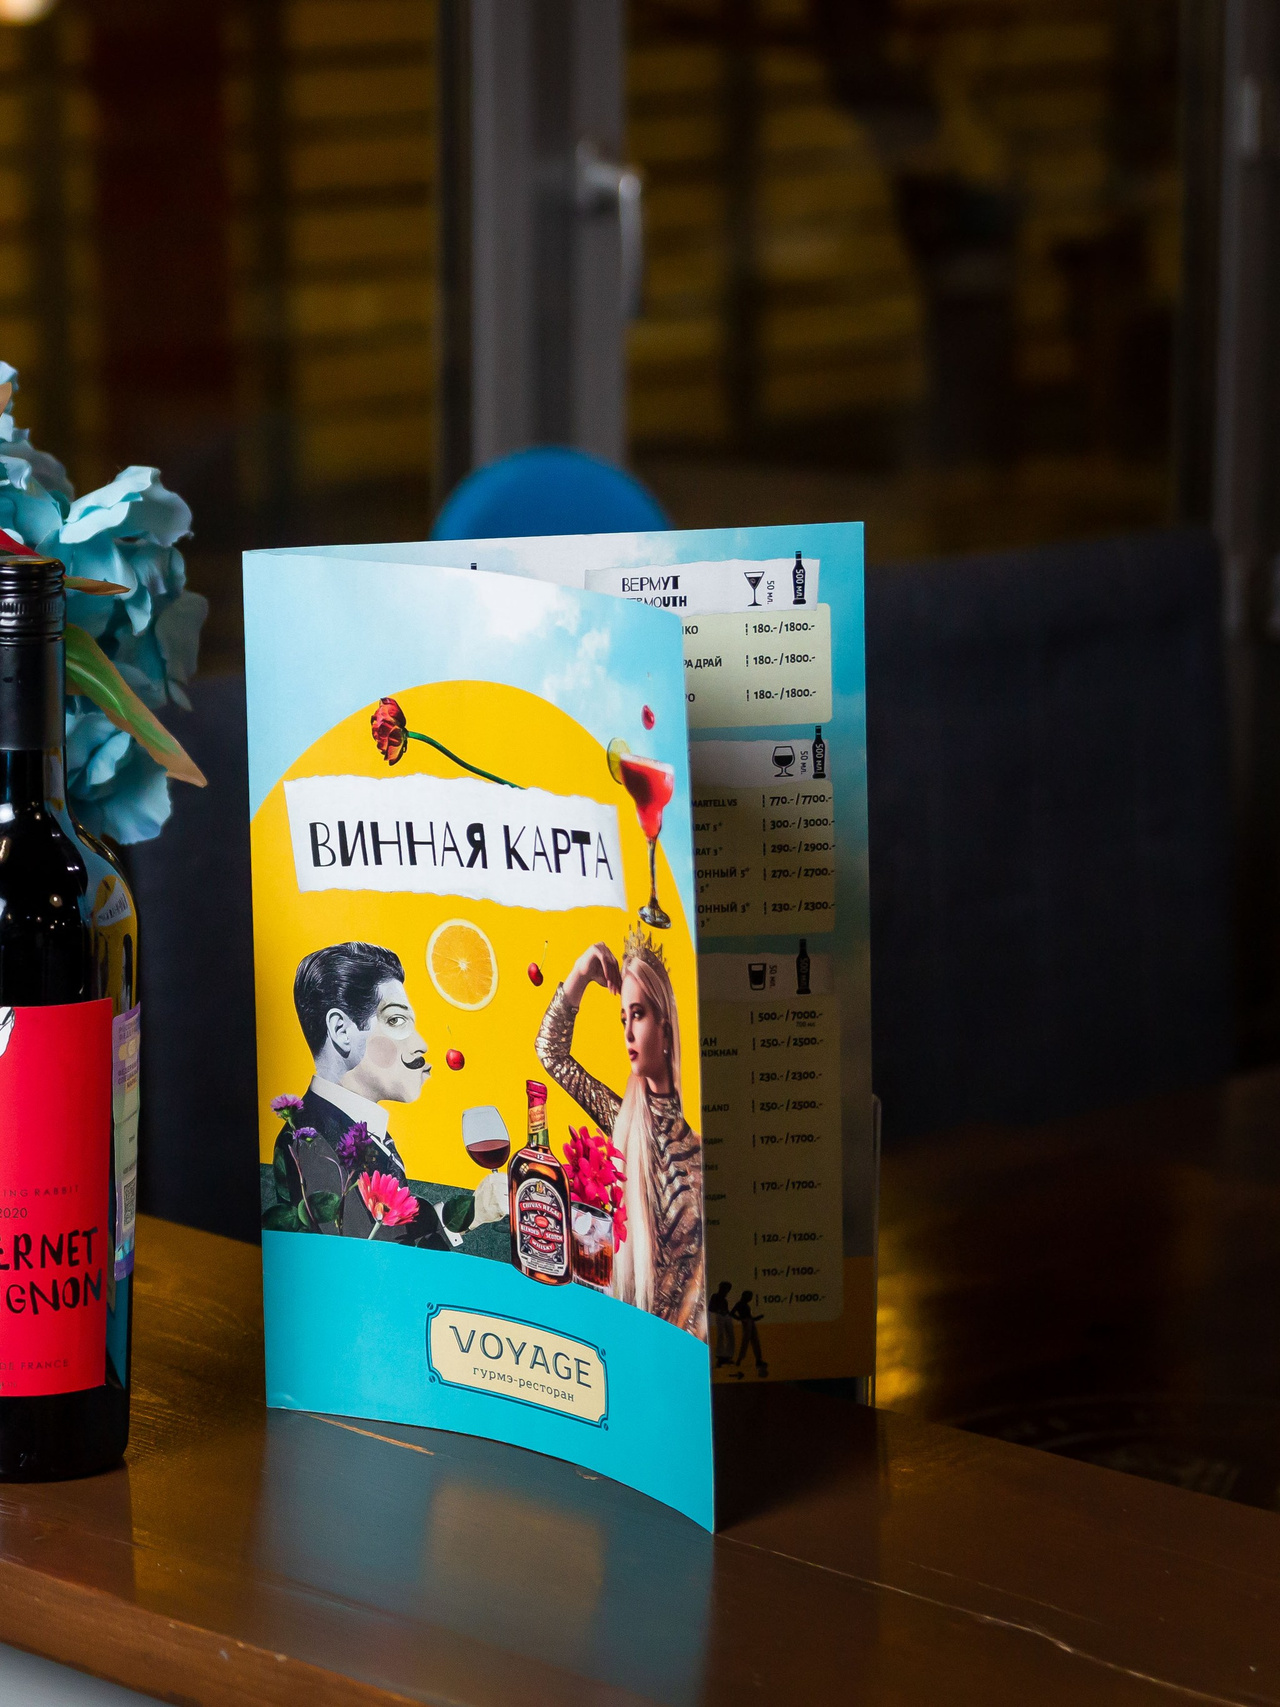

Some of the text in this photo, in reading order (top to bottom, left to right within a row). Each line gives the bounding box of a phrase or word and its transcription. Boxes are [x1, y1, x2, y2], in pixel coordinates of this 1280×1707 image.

[621, 575, 680, 592] ВЕРМУТ
[795, 568, 804, 584] 500
[766, 580, 775, 590] 50
[694, 655, 722, 670] ДРАЙ
[800, 750, 808, 761] 50
[815, 743, 824, 758] 500
[728, 798, 738, 806] VS
[309, 820, 614, 881] ВИННАЯ КАРТА
[34, 1185, 80, 1197] RABBIT
[448, 1325, 593, 1389] VOYAGE
[0, 1362, 14, 1371] DE
[20, 1359, 70, 1371] FRANCE
[472, 1366, 575, 1402] гурмэ-ресторан
